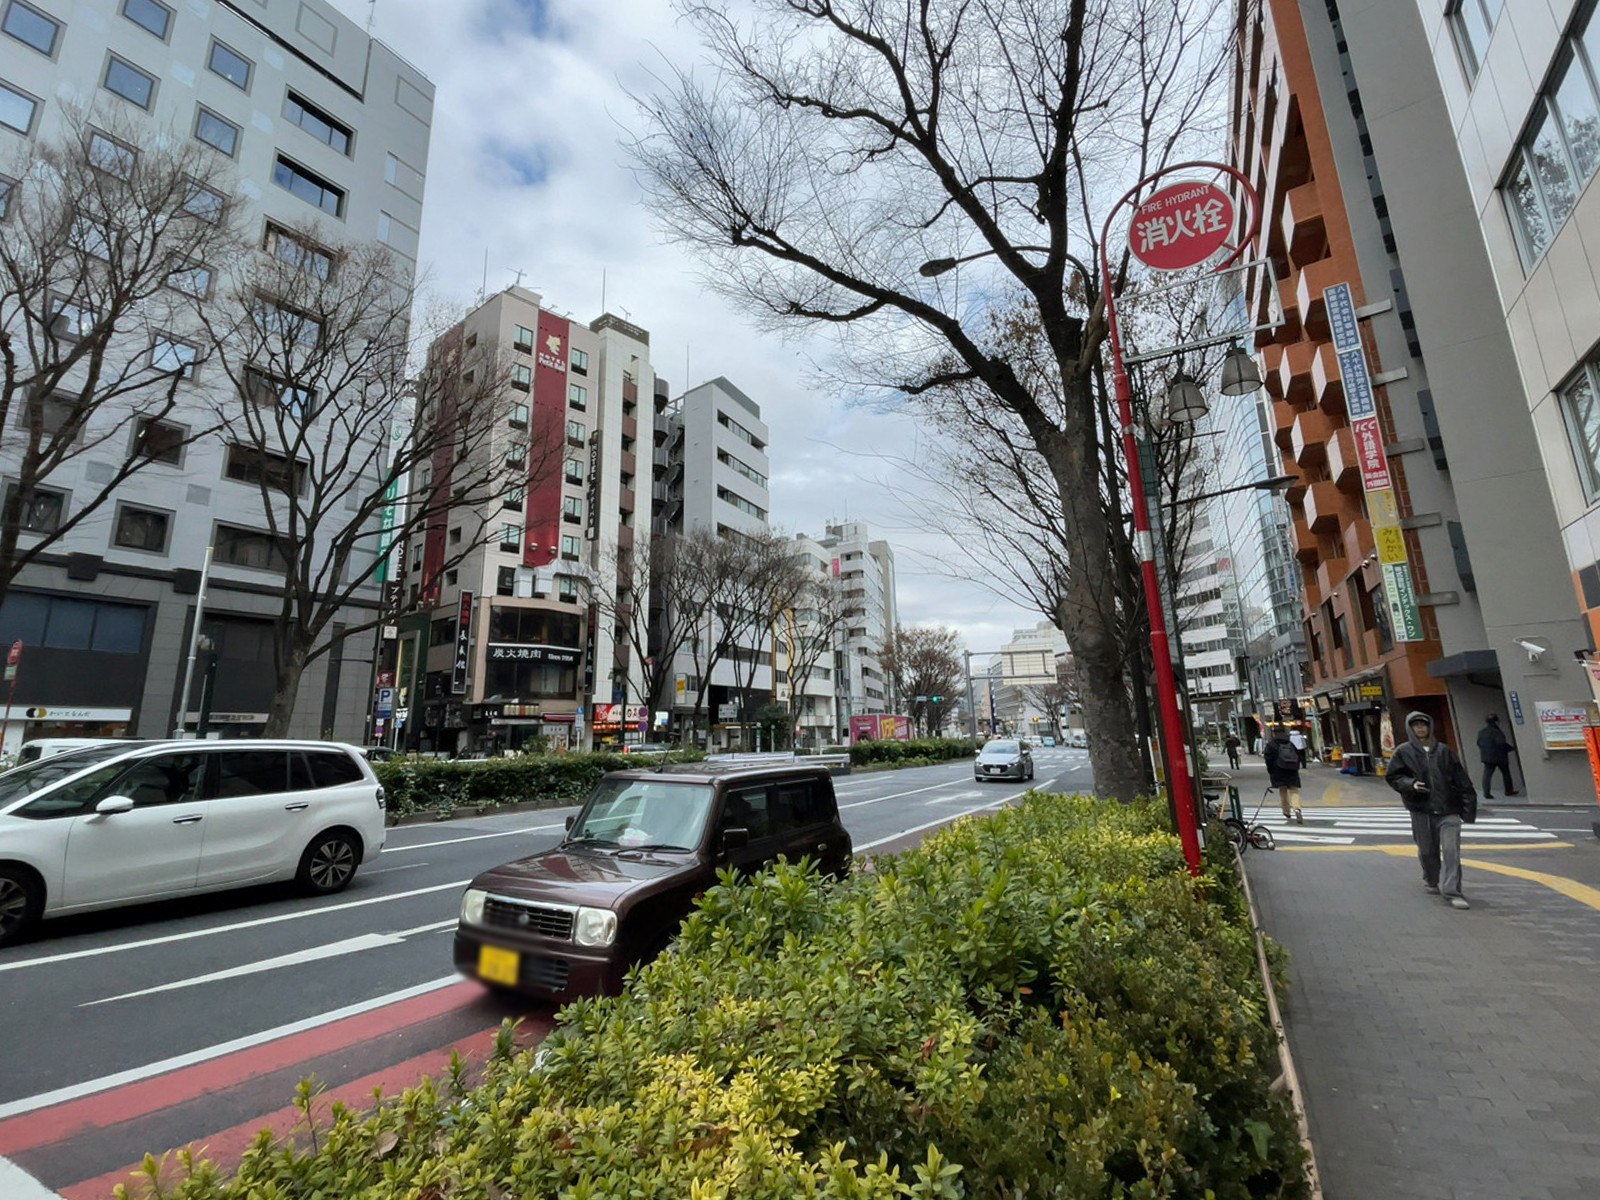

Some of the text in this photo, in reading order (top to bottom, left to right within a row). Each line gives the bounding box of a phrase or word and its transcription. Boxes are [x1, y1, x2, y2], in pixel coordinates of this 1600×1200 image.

[1141, 185, 1210, 215] FIRE HYDRANT
[1136, 198, 1227, 253] 消火栓
[539, 352, 565, 365] HOTEL
[1355, 420, 1376, 432] ICC
[1361, 431, 1380, 470] 外語学院
[380, 690, 391, 702] P
